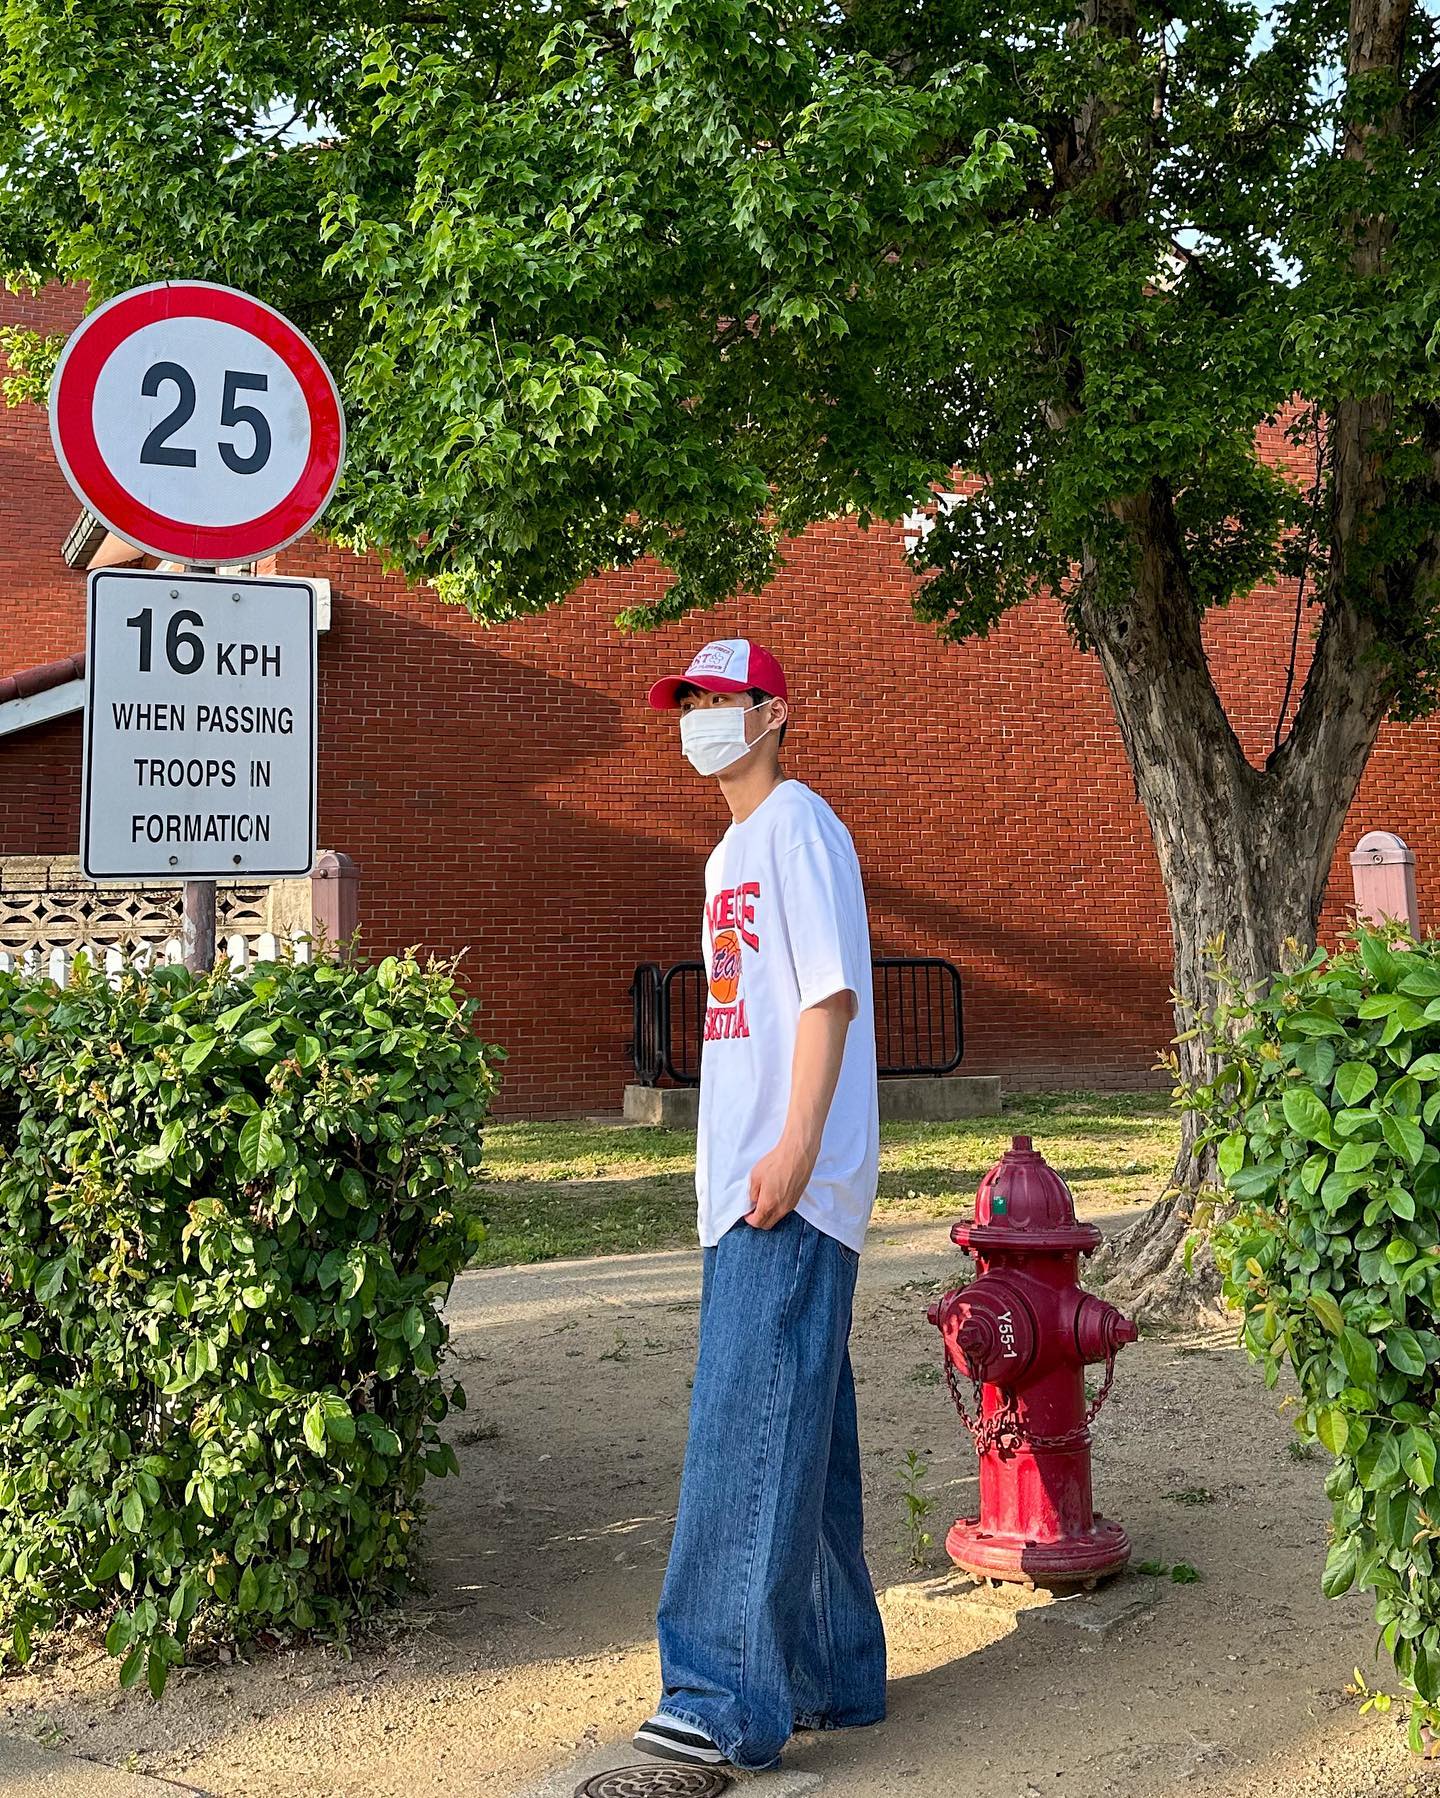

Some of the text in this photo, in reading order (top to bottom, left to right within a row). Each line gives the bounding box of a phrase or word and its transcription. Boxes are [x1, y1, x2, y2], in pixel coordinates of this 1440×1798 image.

[140, 361, 272, 475] 25
[127, 608, 281, 677] 16 KPH
[112, 703, 293, 734] WHEN PASSING
[134, 759, 270, 787] TROOPS IN
[132, 815, 270, 843] FORMATION
[998, 1311, 1018, 1358] Y55-1
